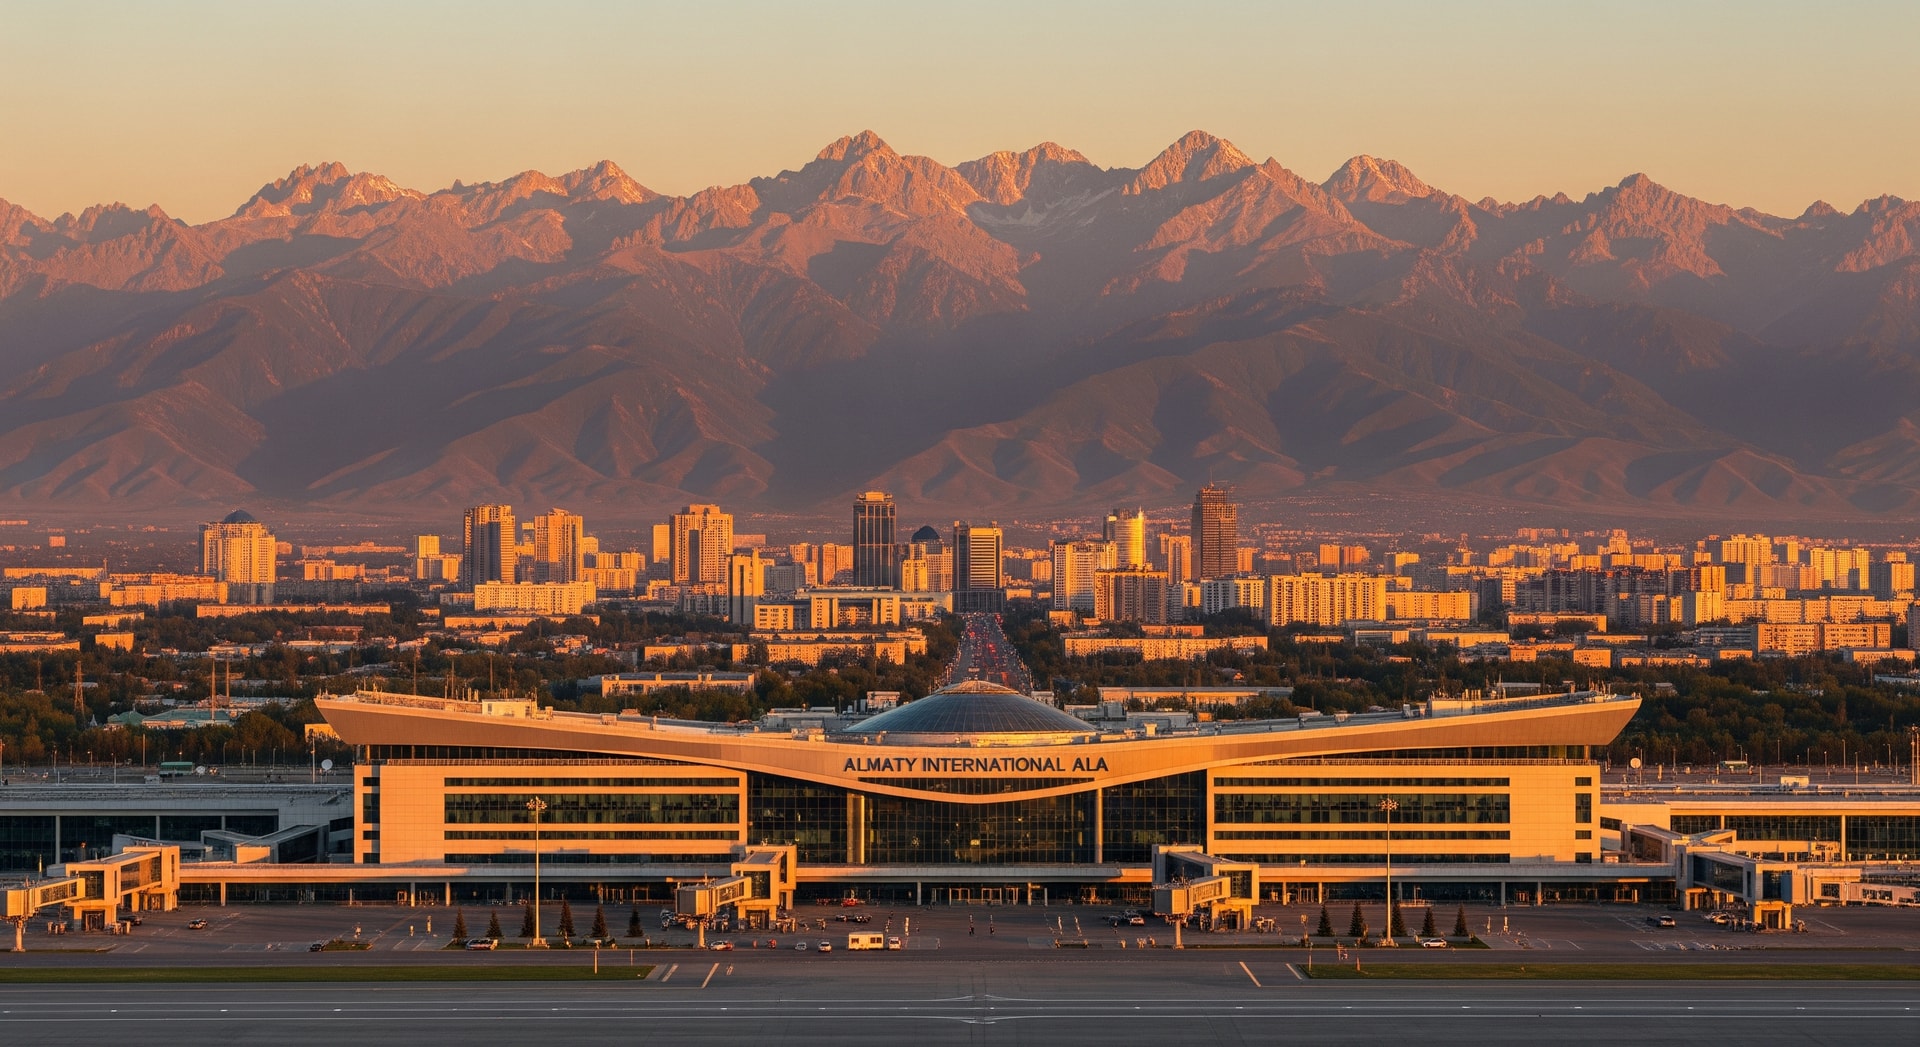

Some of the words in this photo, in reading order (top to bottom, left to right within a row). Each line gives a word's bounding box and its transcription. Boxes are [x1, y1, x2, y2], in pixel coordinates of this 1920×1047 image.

[843, 757, 917, 772] ALMATY
[922, 757, 1066, 772] INTERNATIONAL
[1072, 757, 1109, 772] ALA
